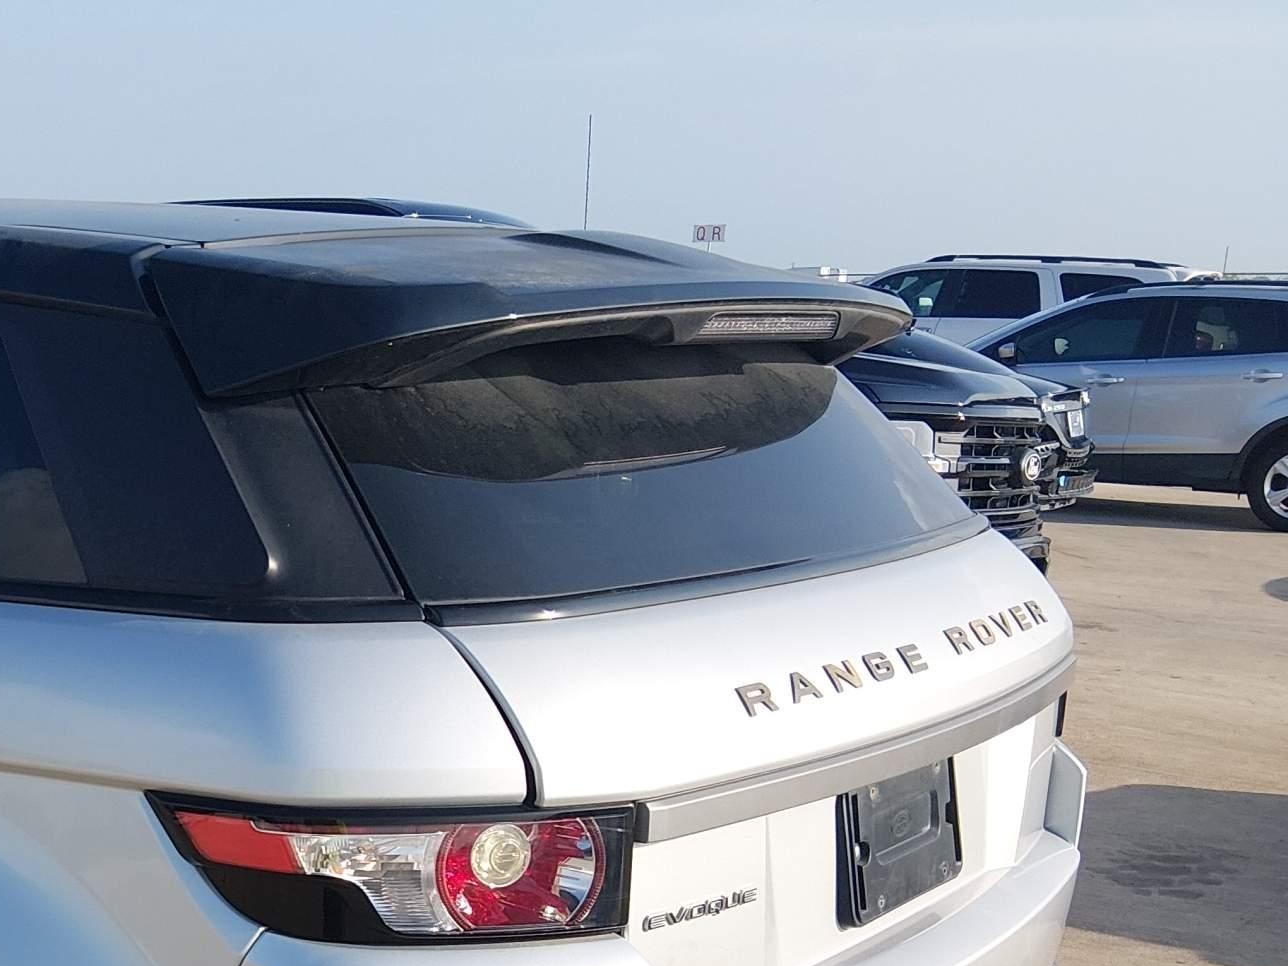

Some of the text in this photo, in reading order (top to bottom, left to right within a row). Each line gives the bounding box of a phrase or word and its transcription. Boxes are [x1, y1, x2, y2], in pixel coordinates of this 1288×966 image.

[697, 226, 721, 241] Q R
[734, 600, 1048, 717] RANGE ROVER
[642, 888, 758, 932] EVOQUE
